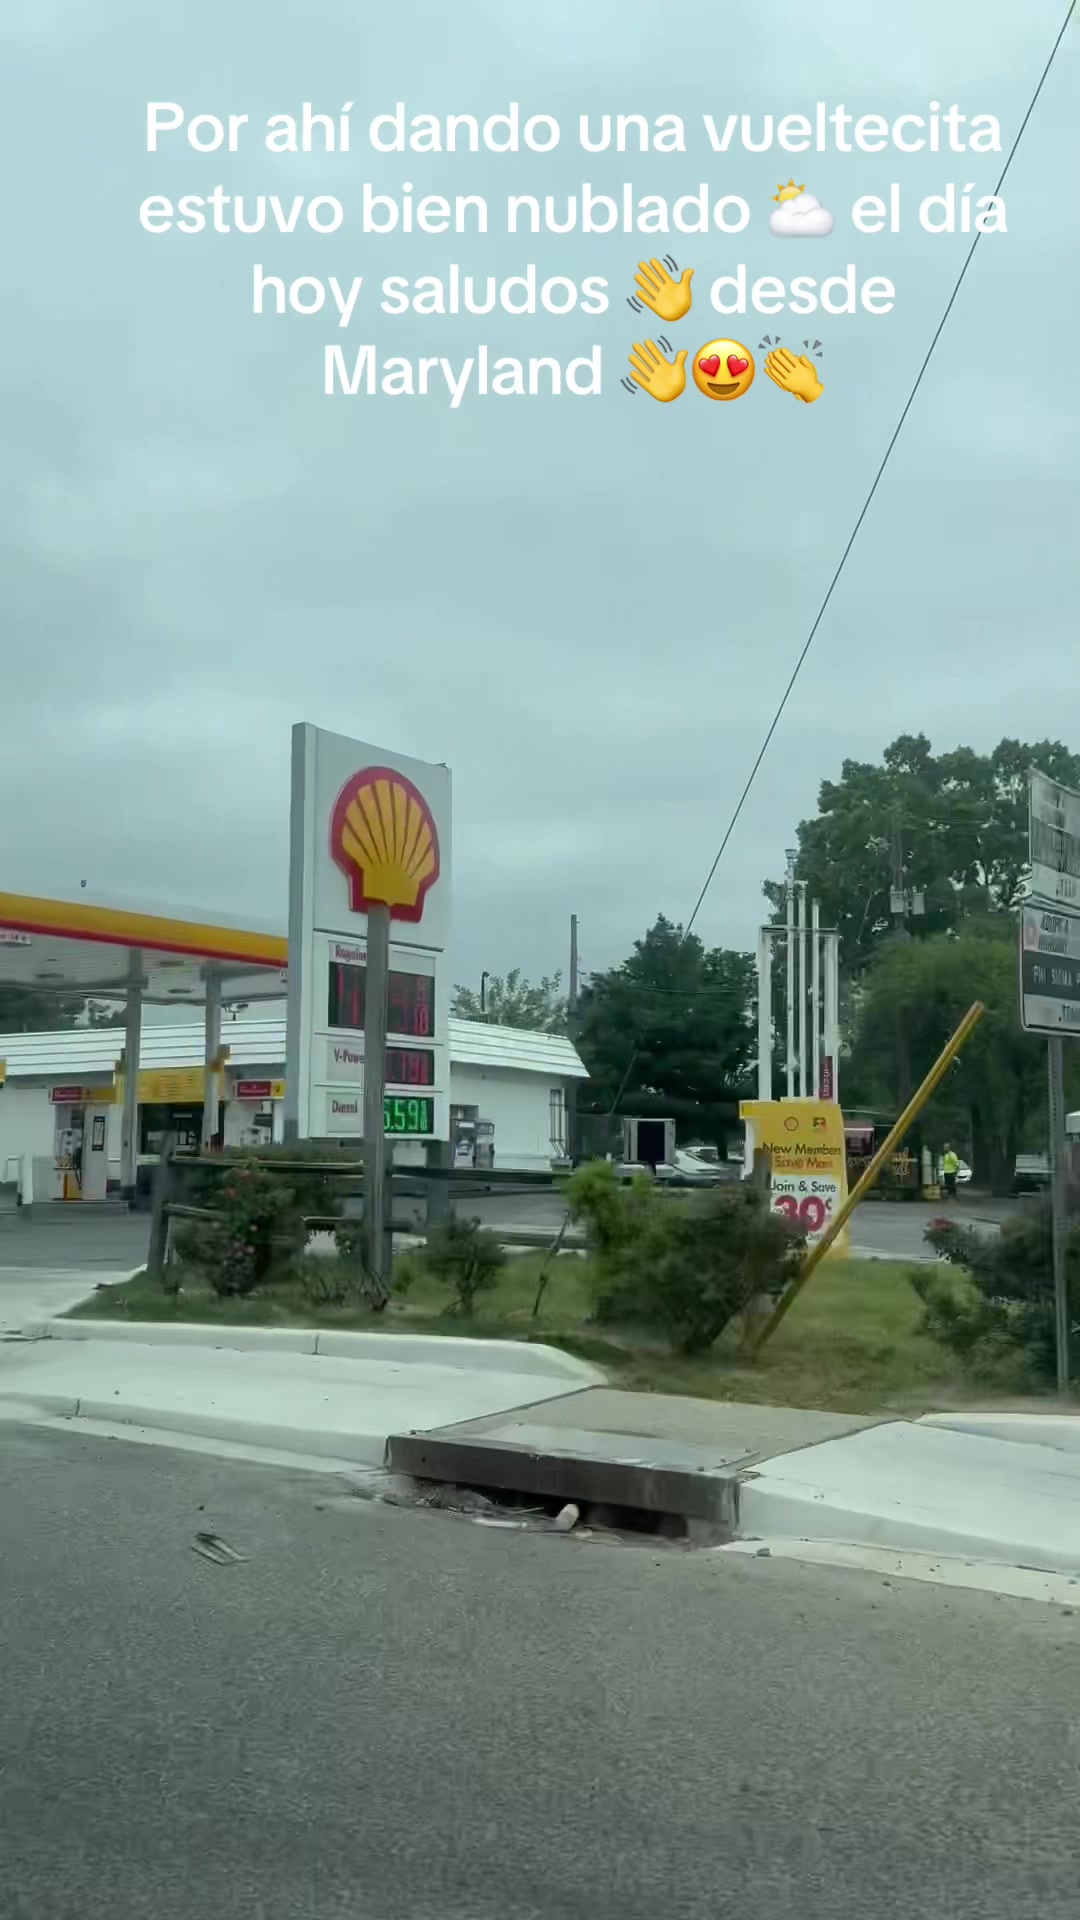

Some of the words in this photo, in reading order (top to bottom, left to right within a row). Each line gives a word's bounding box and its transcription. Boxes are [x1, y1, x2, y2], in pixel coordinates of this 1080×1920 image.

[762, 1142, 792, 1154] New
[770, 1179, 795, 1192] Join
[799, 1180, 808, 1192] &
[811, 1181, 837, 1193] Save
